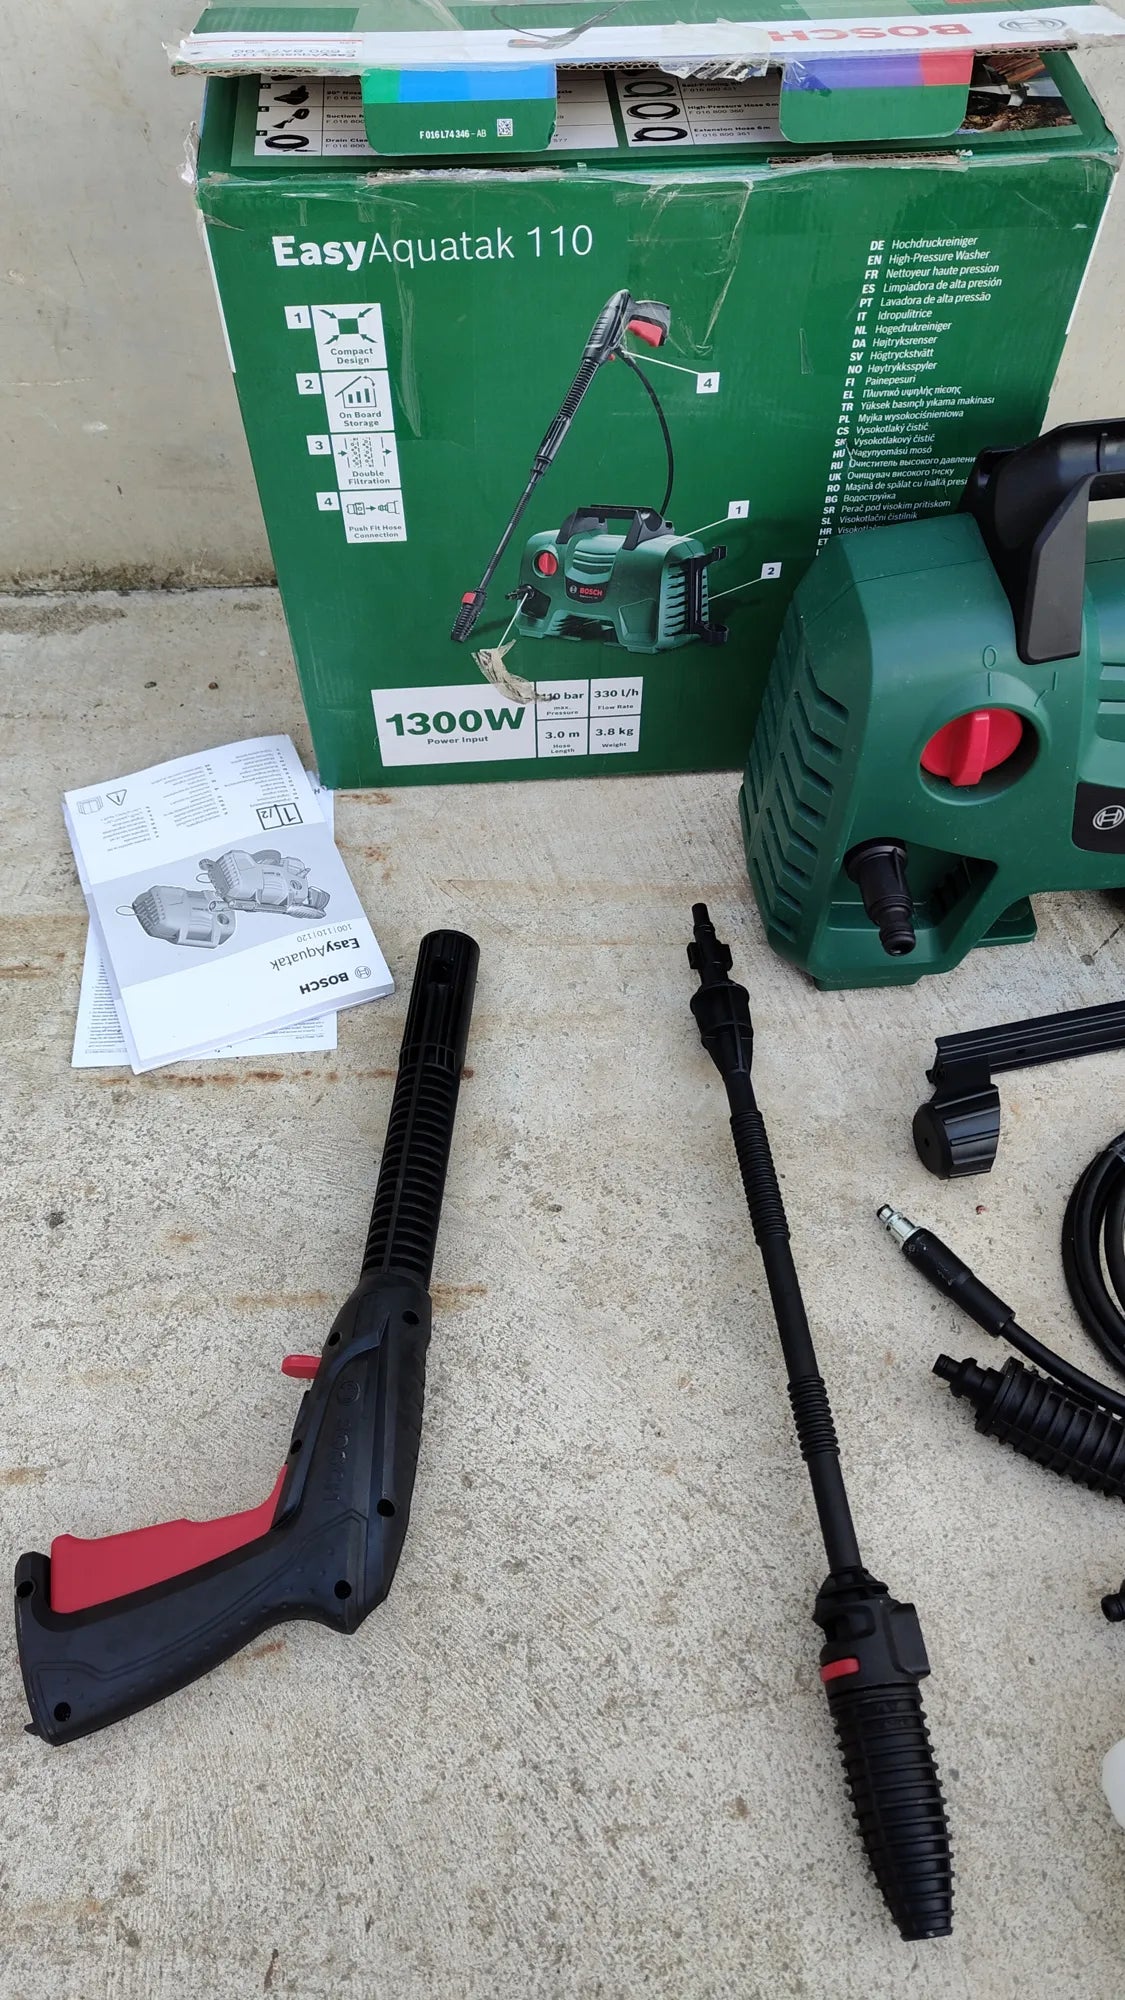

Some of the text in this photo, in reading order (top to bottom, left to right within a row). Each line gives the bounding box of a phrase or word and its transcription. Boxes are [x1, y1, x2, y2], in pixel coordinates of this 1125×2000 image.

[768, 24, 972, 42] BOSCH
[420, 130, 424, 140] F
[426, 130, 440, 139] 016
[440, 130, 454, 138] L74
[456, 130, 470, 138] 346
[272, 225, 594, 272] EasyAquatak 110
[870, 236, 978, 251] DE Hochdruckreiniger
[868, 250, 990, 266] EN High-Pressure Washer
[865, 264, 999, 279] FR Nettoyeur haute pression
[862, 277, 1002, 294] ES Limpiadora de alta presión
[860, 292, 990, 307] PT Lavadora de alta pressão
[294, 312, 302, 324] 1
[857, 309, 932, 321] IT Idropulitrice
[855, 322, 952, 335] NL Hogedrukreiniger
[852, 339, 866, 348] DA
[330, 348, 374, 356] Compact
[850, 349, 934, 362] SV Högtryckstvätt
[336, 357, 370, 365] Design
[848, 365, 862, 374] NO
[304, 380, 314, 390] 2
[703, 378, 714, 389] 4
[845, 375, 916, 386] FI Painepesuri
[843, 391, 854, 399] EL
[842, 403, 853, 411] TR
[861, 400, 890, 410] Yüksek
[354, 410, 382, 418] Board
[839, 415, 850, 423] PL
[858, 412, 883, 423] Myjka
[315, 440, 324, 450] 3
[833, 449, 845, 458] HU
[831, 461, 843, 470] RU
[939, 456, 976, 466] давлени
[947, 478, 967, 487] presi
[324, 498, 332, 506] 4
[735, 506, 742, 514] 1
[768, 566, 775, 576] 2
[580, 588, 602, 596] BOSCH
[564, 692, 584, 700] bar
[594, 688, 639, 698] 330 l/h
[386, 706, 526, 736] 1300W
[545, 731, 564, 740] 3.0
[596, 727, 634, 736] 3.8 kg
[270, 938, 360, 972] EasyAquatak
[300, 972, 349, 994] BOSCH
